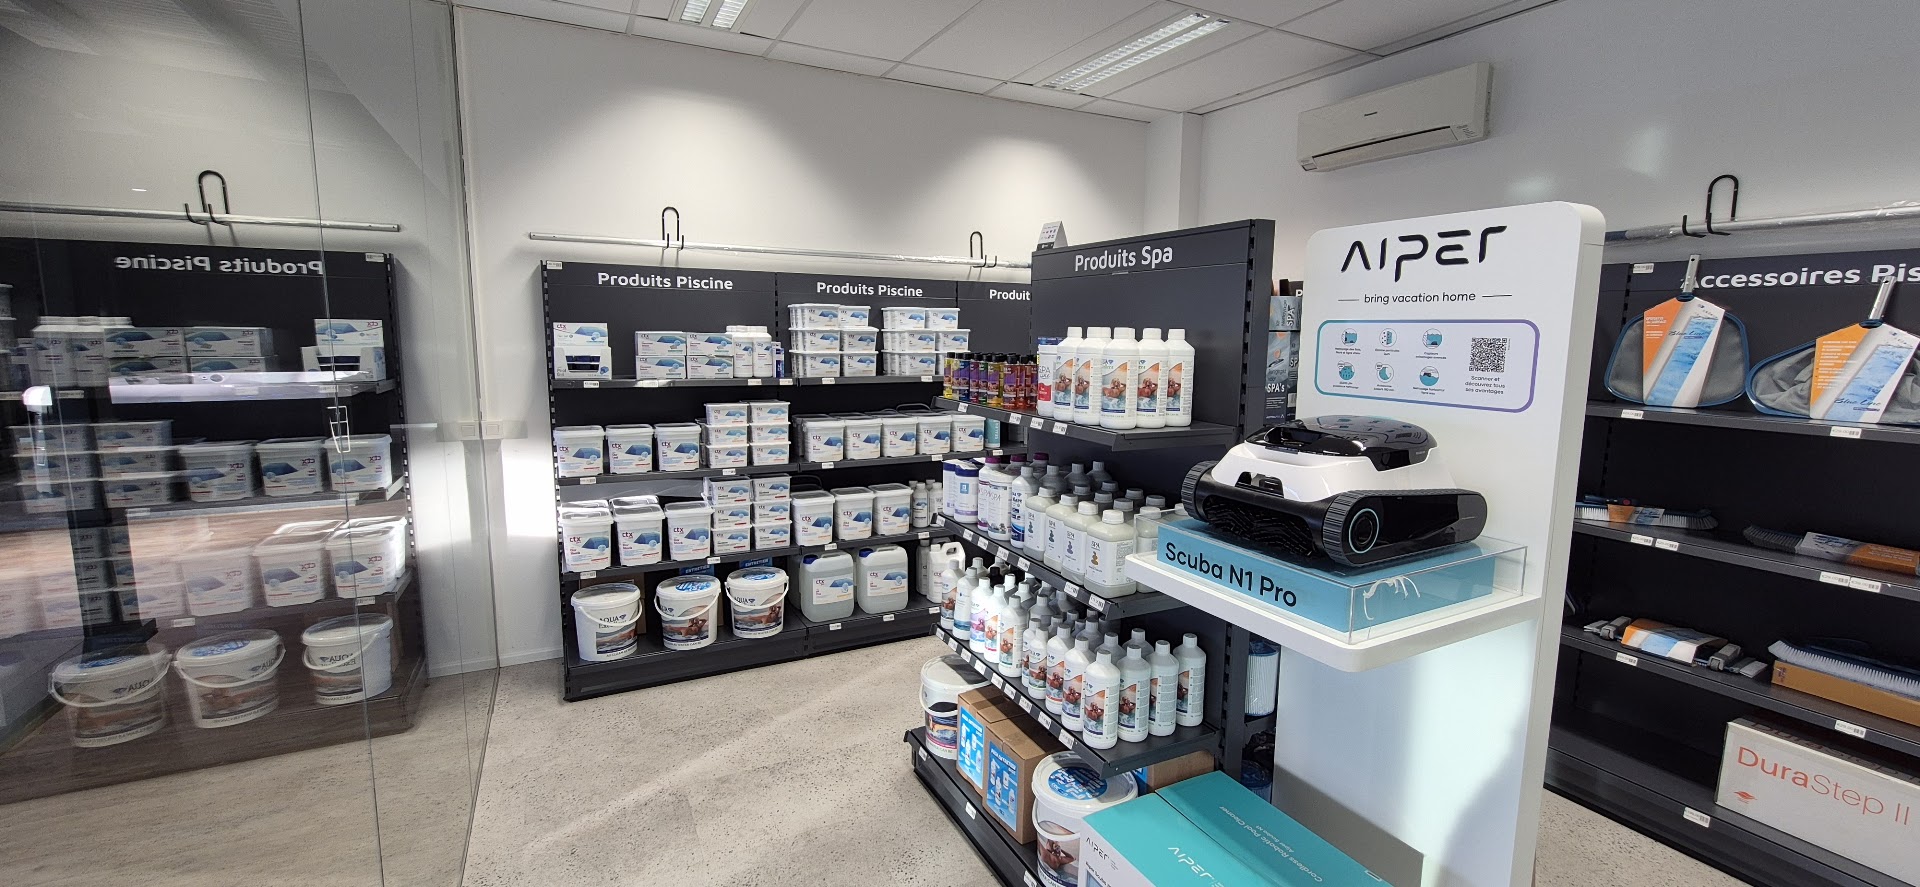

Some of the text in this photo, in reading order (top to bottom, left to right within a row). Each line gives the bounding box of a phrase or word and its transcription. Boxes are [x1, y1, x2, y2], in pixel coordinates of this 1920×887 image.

[1075, 246, 1173, 272] Produits Spa
[1341, 225, 1507, 283] AIPER
[598, 272, 733, 290] Produits Piscine
[816, 281, 923, 297] Produits Piscine
[1364, 291, 1476, 305] bring vacation home
[1290, 358, 1298, 366] SP
[1266, 383, 1284, 392] SPA's
[1166, 542, 1297, 607] Scuba N1 Pro
[1737, 746, 1910, 826] DuraStep II
[1086, 837, 1110, 860] AIPER
[1220, 806, 1322, 882] Cordless Robotic Pool Cleaner
[1168, 848, 1212, 877] AIPER
